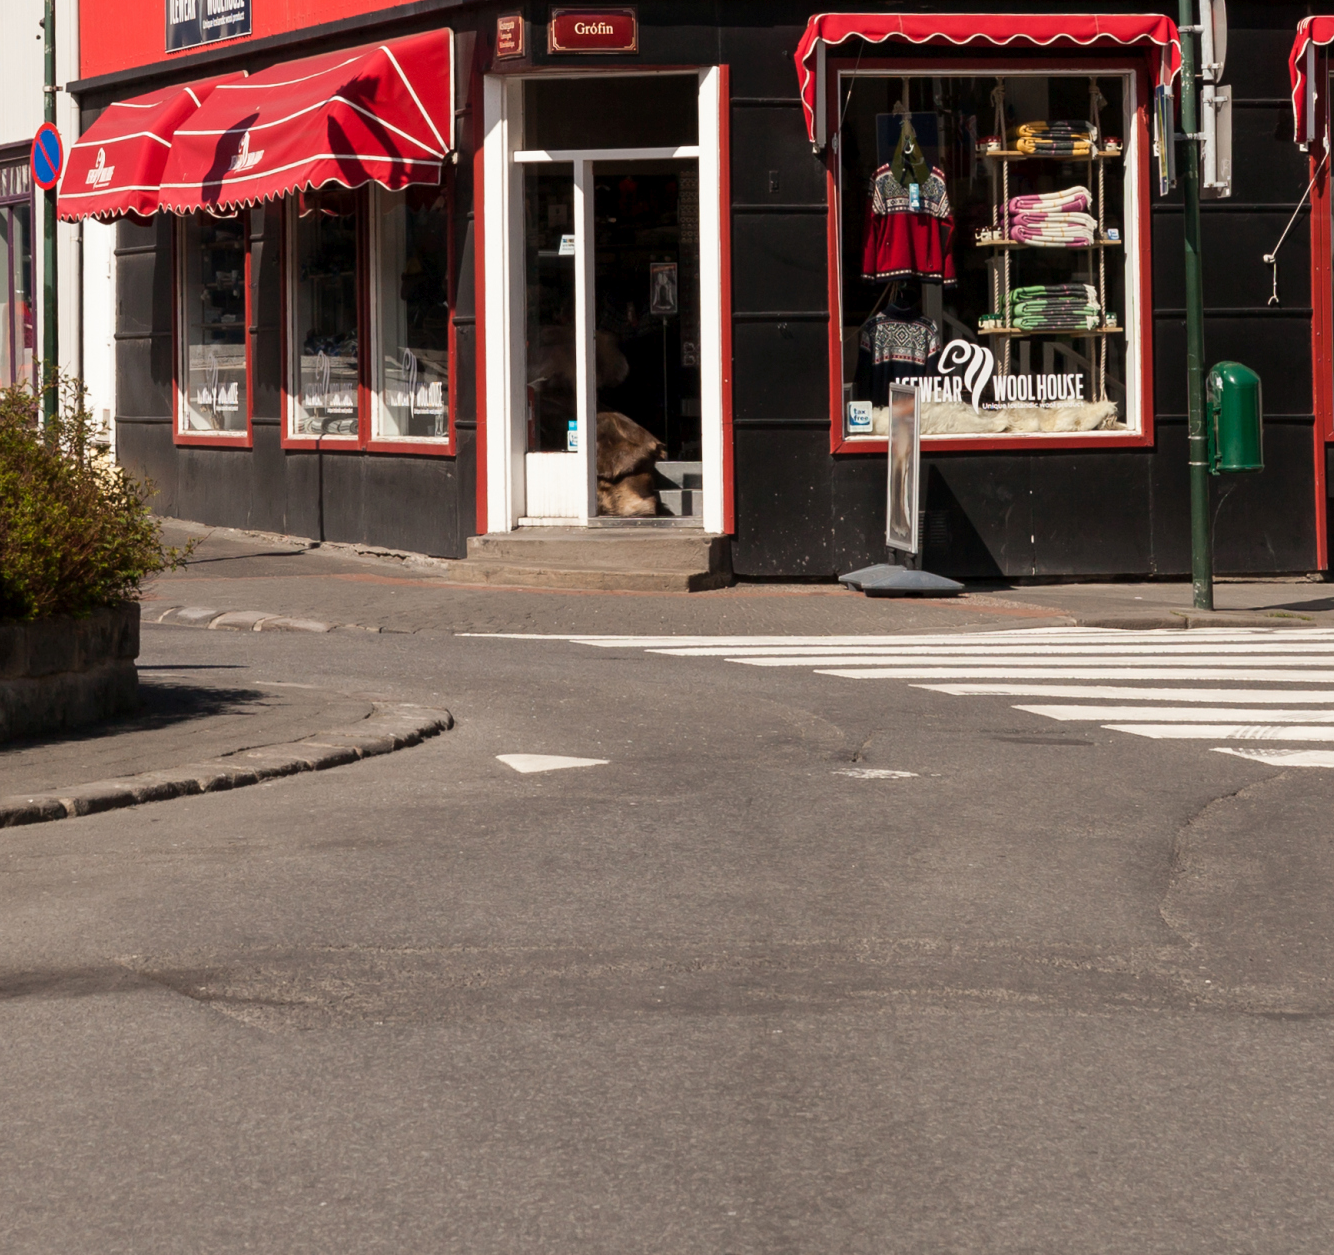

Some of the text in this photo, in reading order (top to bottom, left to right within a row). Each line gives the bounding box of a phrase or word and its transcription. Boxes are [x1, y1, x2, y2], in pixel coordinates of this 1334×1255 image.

[574, 22, 614, 35] Grófin
[982, 402, 1007, 411] Unique
[1008, 401, 1038, 409] Icelandic
[1040, 401, 1055, 409] wool
